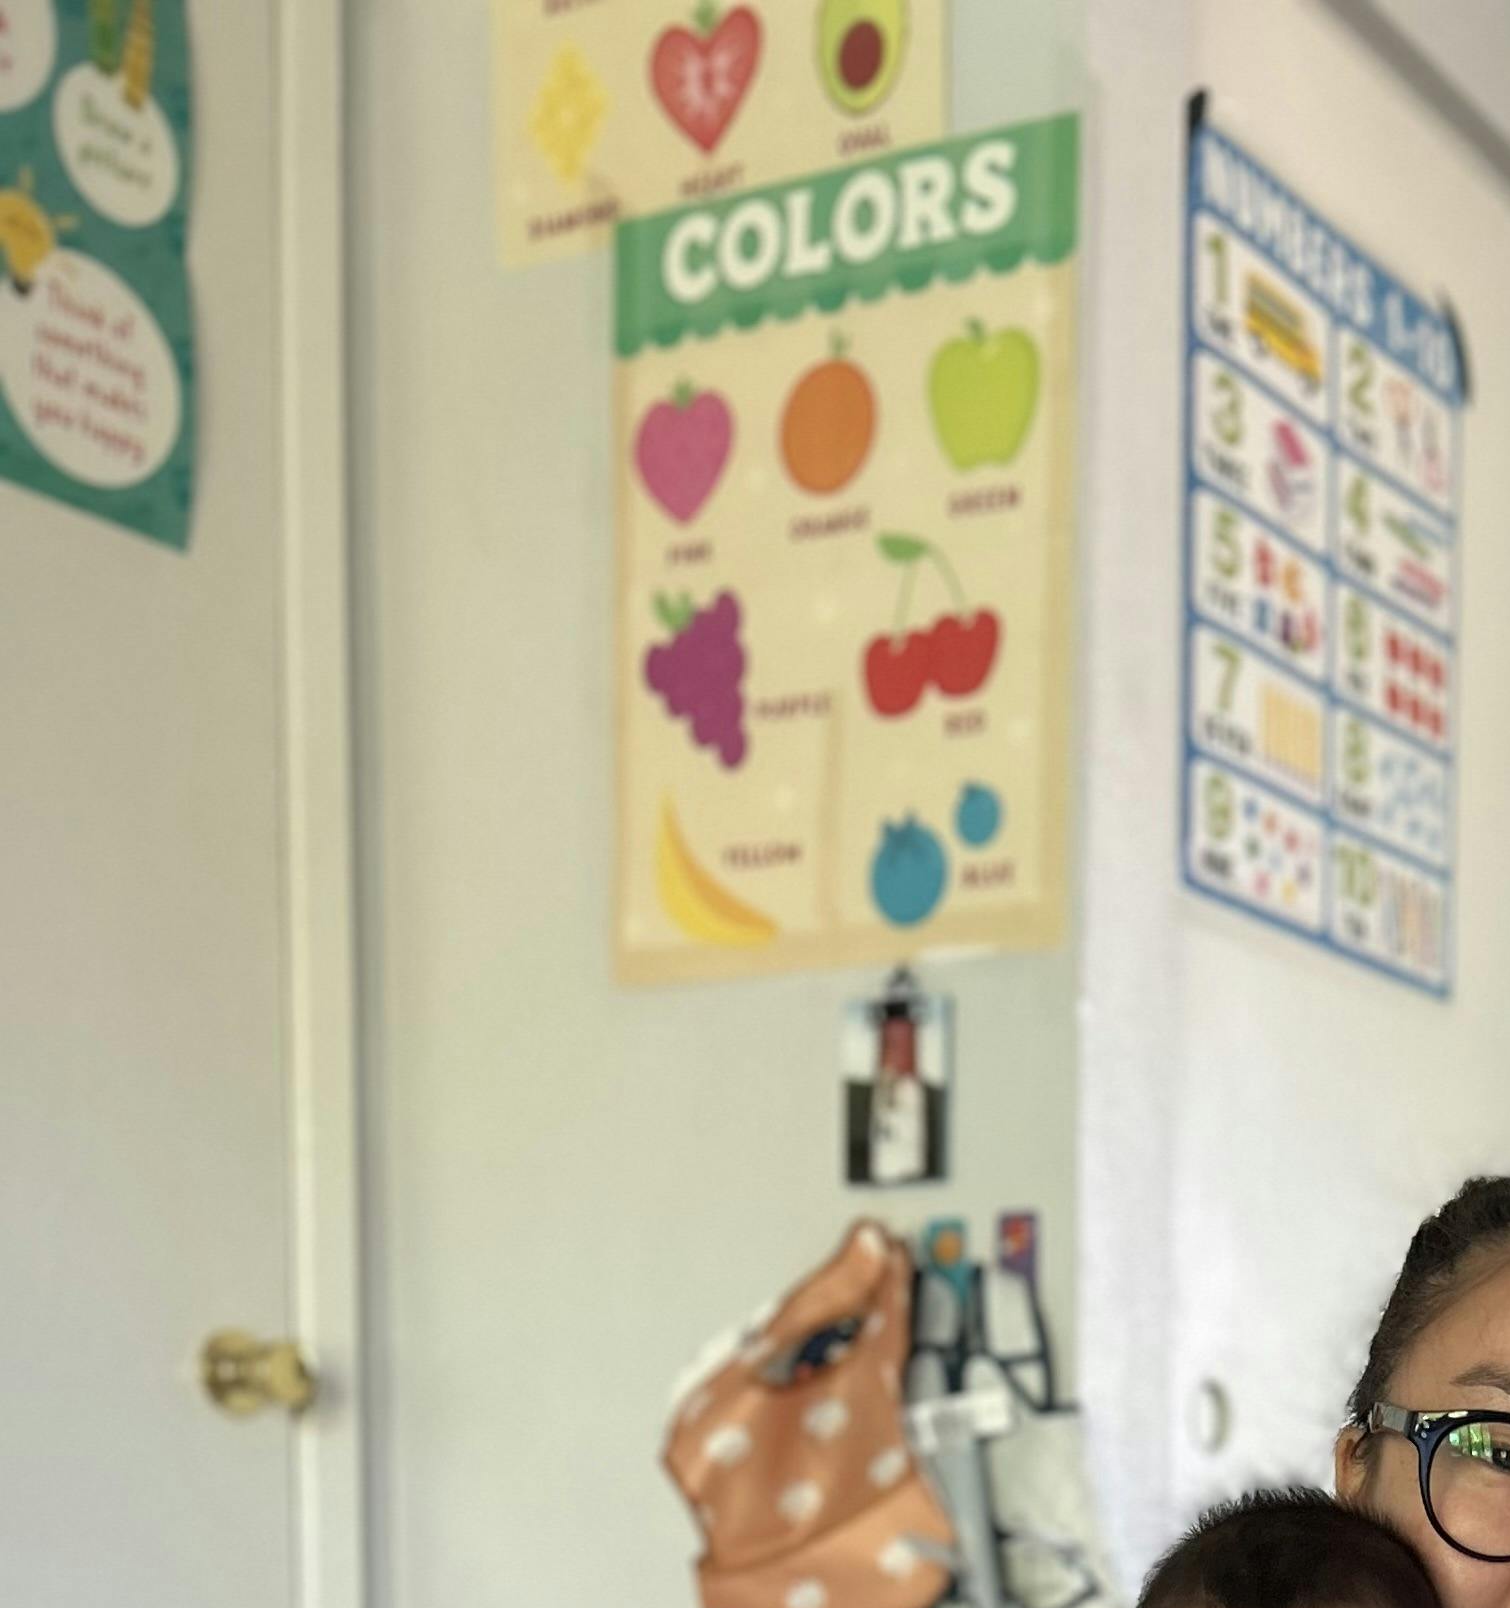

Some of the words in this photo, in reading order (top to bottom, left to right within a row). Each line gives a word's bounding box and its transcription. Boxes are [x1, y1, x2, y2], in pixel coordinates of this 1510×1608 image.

[662, 140, 1017, 302] COLORS
[1204, 136, 1374, 328] NUMBERS
[1206, 231, 1232, 307] 1
[1212, 370, 1243, 447] 3
[1348, 341, 1375, 417] 2
[1212, 506, 1241, 580] 5
[1211, 640, 1243, 711] 7
